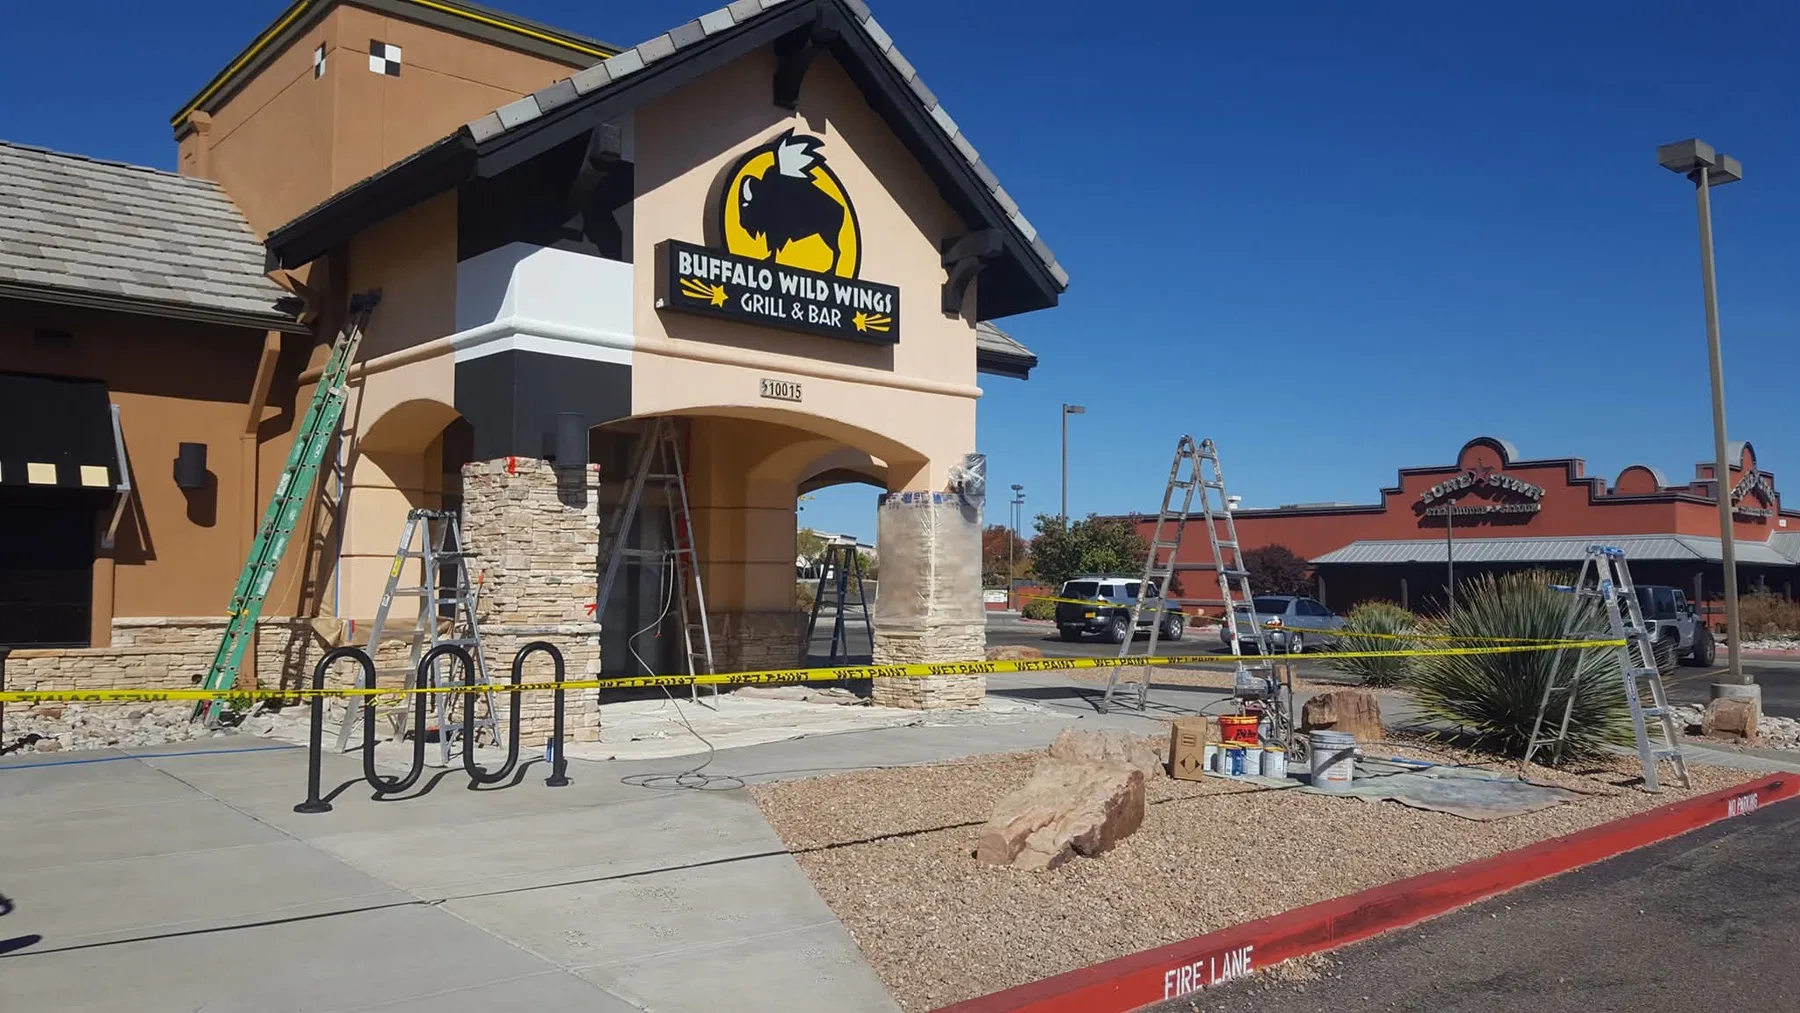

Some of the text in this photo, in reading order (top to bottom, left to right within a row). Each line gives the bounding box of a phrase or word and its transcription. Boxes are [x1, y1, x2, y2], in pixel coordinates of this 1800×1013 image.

[679, 250, 892, 314] BUFFALO WILD WINGS
[741, 292, 842, 328] GRILL & BAR
[1420, 473, 1546, 504] LONE STAR
[1014, 659, 1076, 671] WET PAINT
[1093, 657, 1150, 667] WET PAINT
[833, 667, 907, 680] WET PAINT
[928, 663, 995, 675] WET PAINT
[727, 674, 760, 683] WET
[1164, 945, 1254, 1000] FIRE LANE
